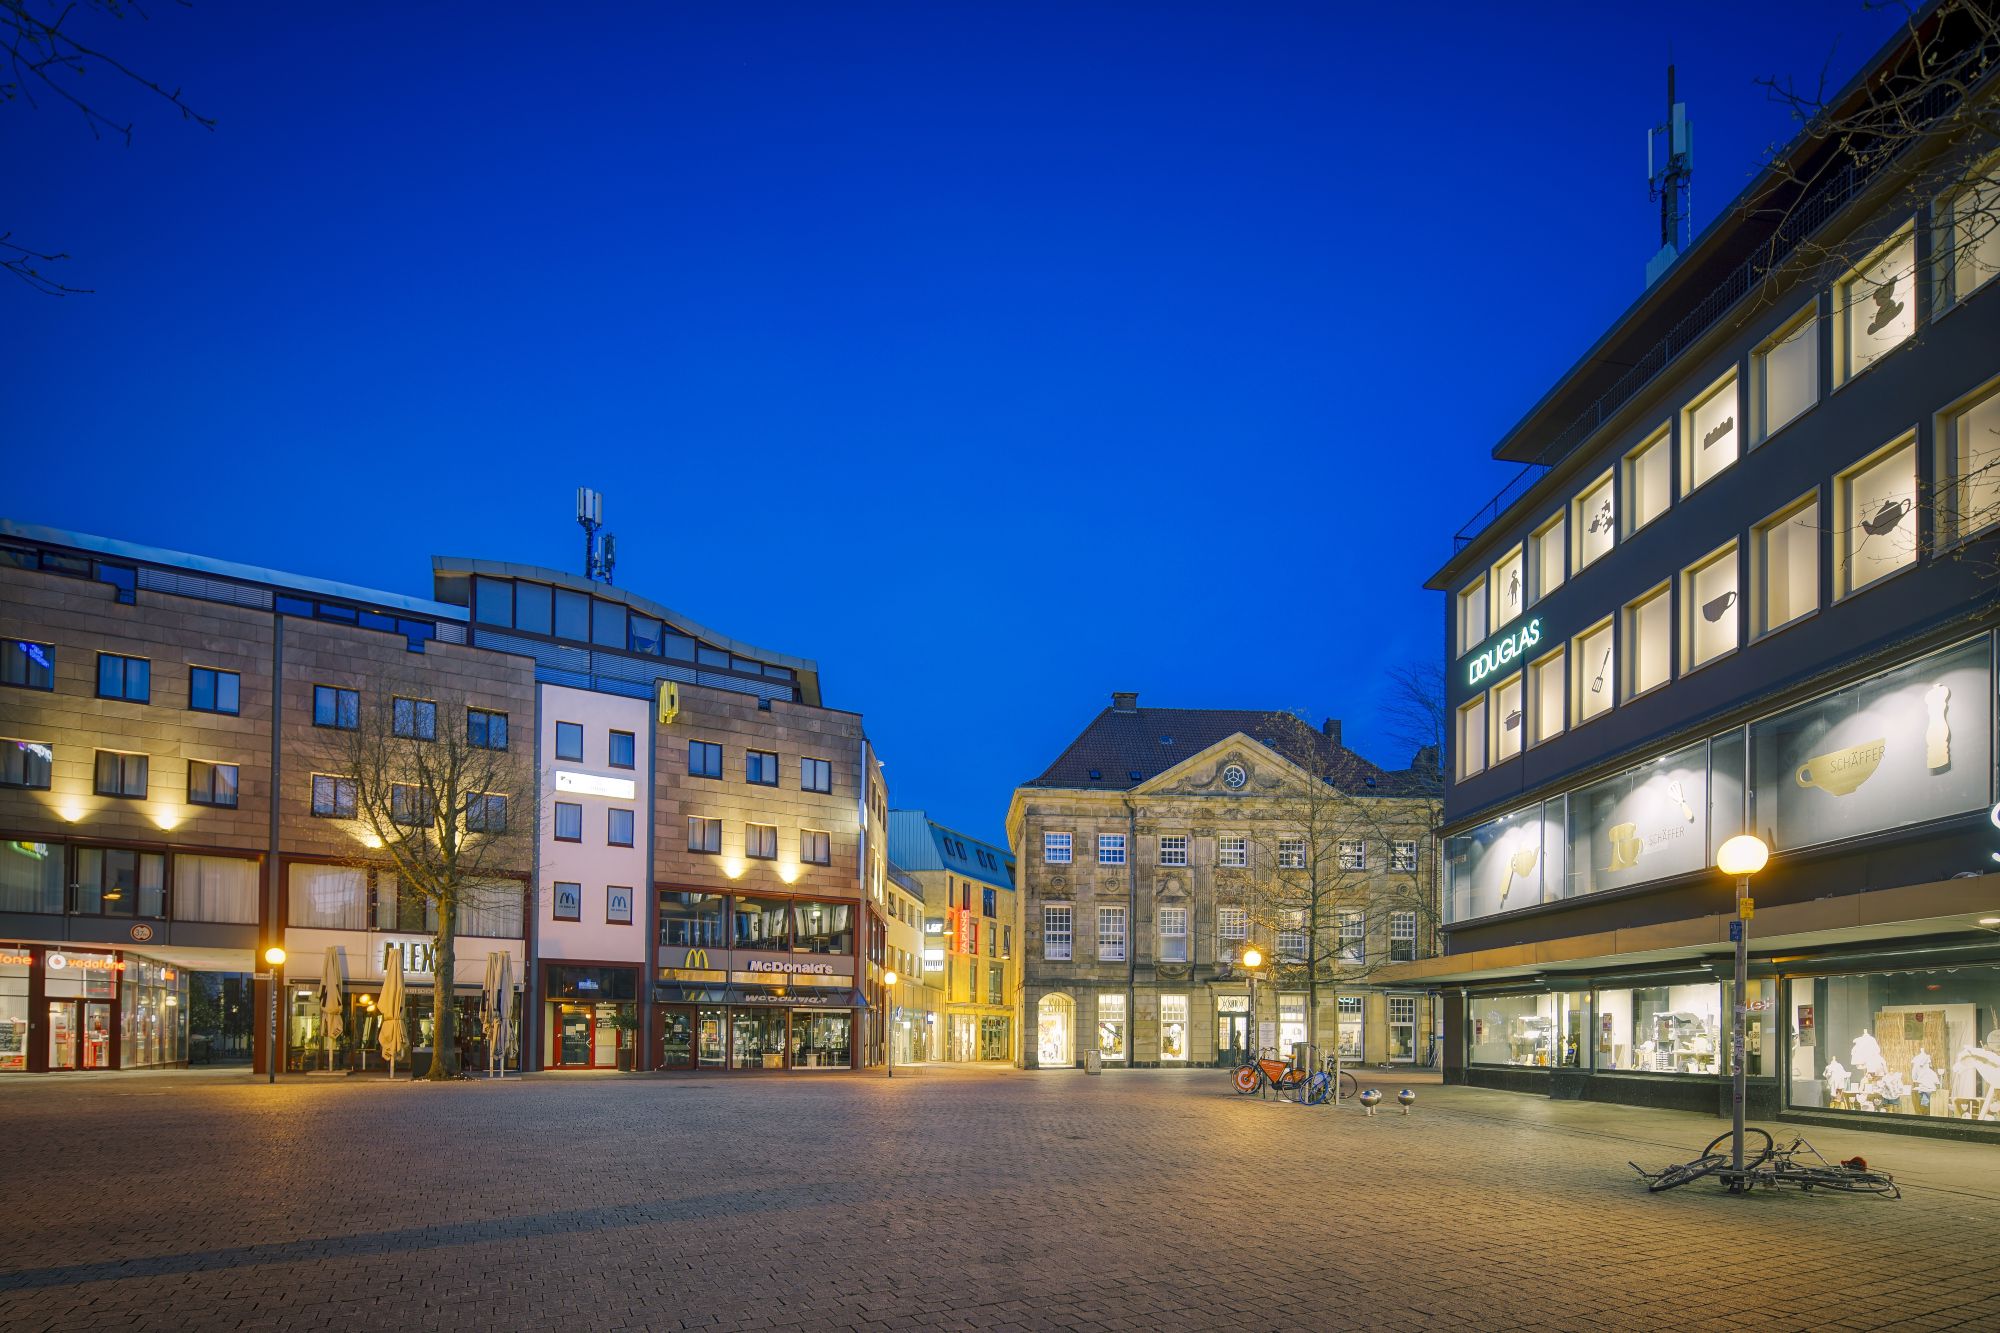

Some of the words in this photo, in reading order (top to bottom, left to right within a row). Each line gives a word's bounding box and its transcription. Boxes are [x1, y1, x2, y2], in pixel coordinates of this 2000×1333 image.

[1469, 618, 1541, 686] DOUGLAS
[1829, 744, 1887, 775] SCHÄFFER
[1647, 825, 1686, 848] SCHÄFFER
[68, 958, 126, 971] vodafone
[748, 960, 833, 974] McDonald's
